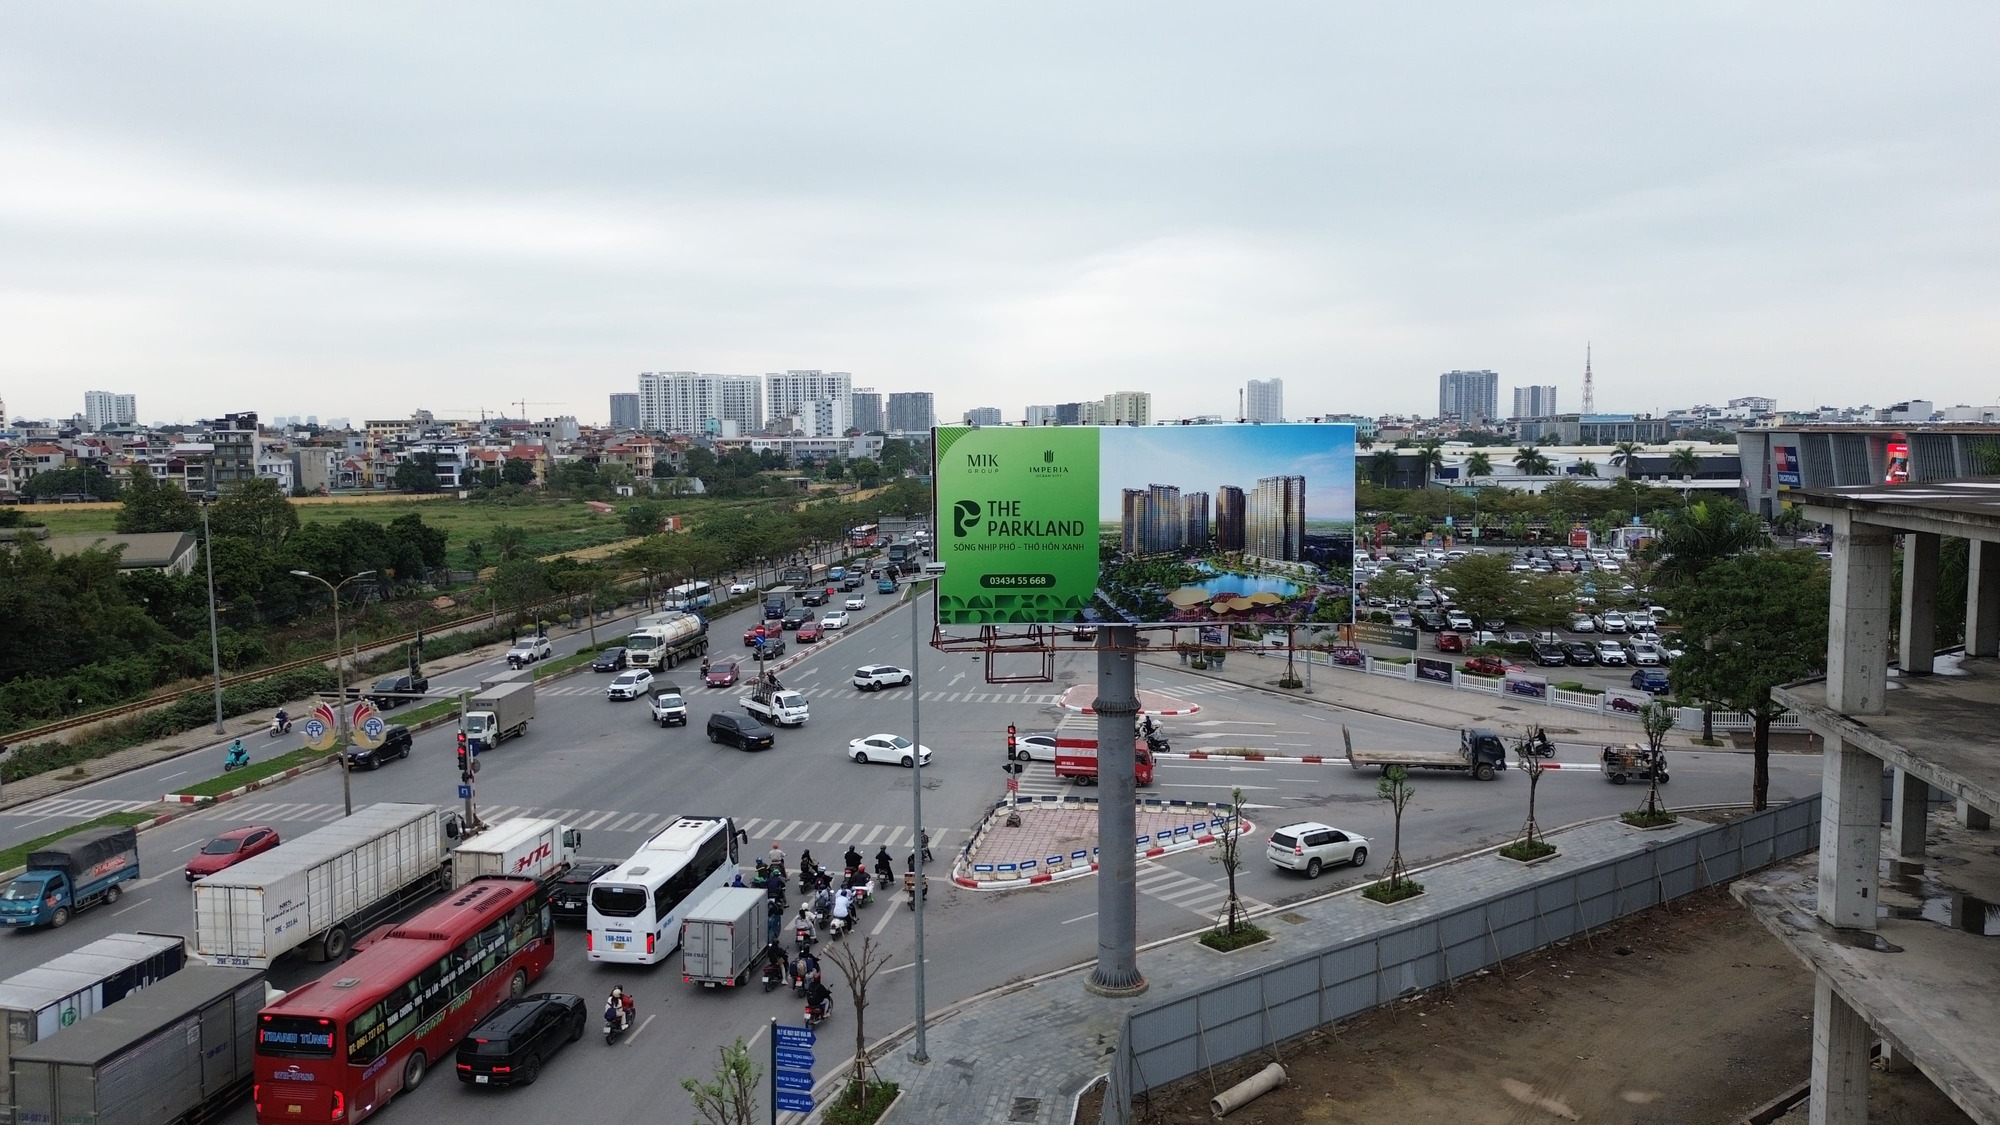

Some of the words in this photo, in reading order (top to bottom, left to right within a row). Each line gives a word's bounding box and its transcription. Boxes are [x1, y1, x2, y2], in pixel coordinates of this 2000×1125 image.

[967, 454, 999, 467] MIK
[987, 501, 1021, 517] THE
[988, 521, 1085, 537] PARKLAND
[1062, 543, 1085, 551] XANH
[990, 577, 1016, 585] 03434
[1018, 577, 1028, 585] 55
[1030, 577, 1046, 585] 668
[514, 842, 551, 873] HTL
[264, 1031, 297, 1043] THANH
